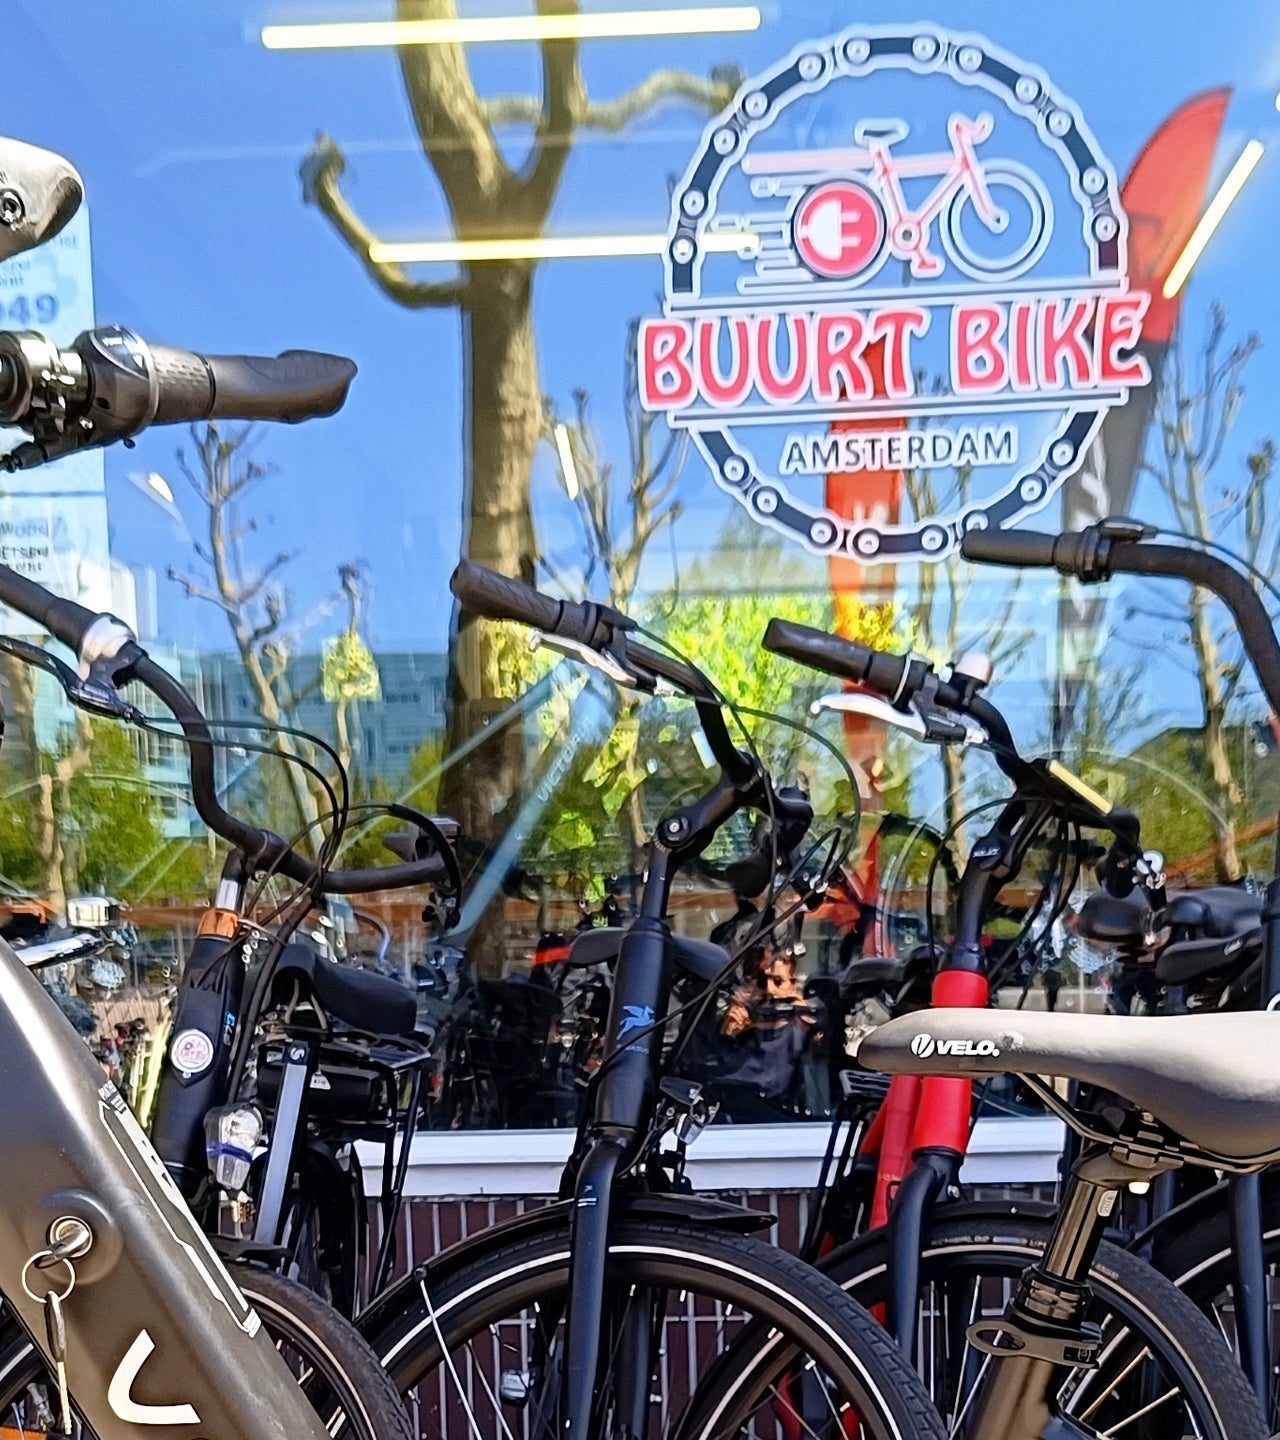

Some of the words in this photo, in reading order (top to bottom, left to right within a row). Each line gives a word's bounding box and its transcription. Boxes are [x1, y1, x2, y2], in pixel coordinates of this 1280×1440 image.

[641, 306, 928, 407] BUURT
[954, 294, 1150, 391] BIKE
[785, 432, 1013, 469] AMSTERDAM
